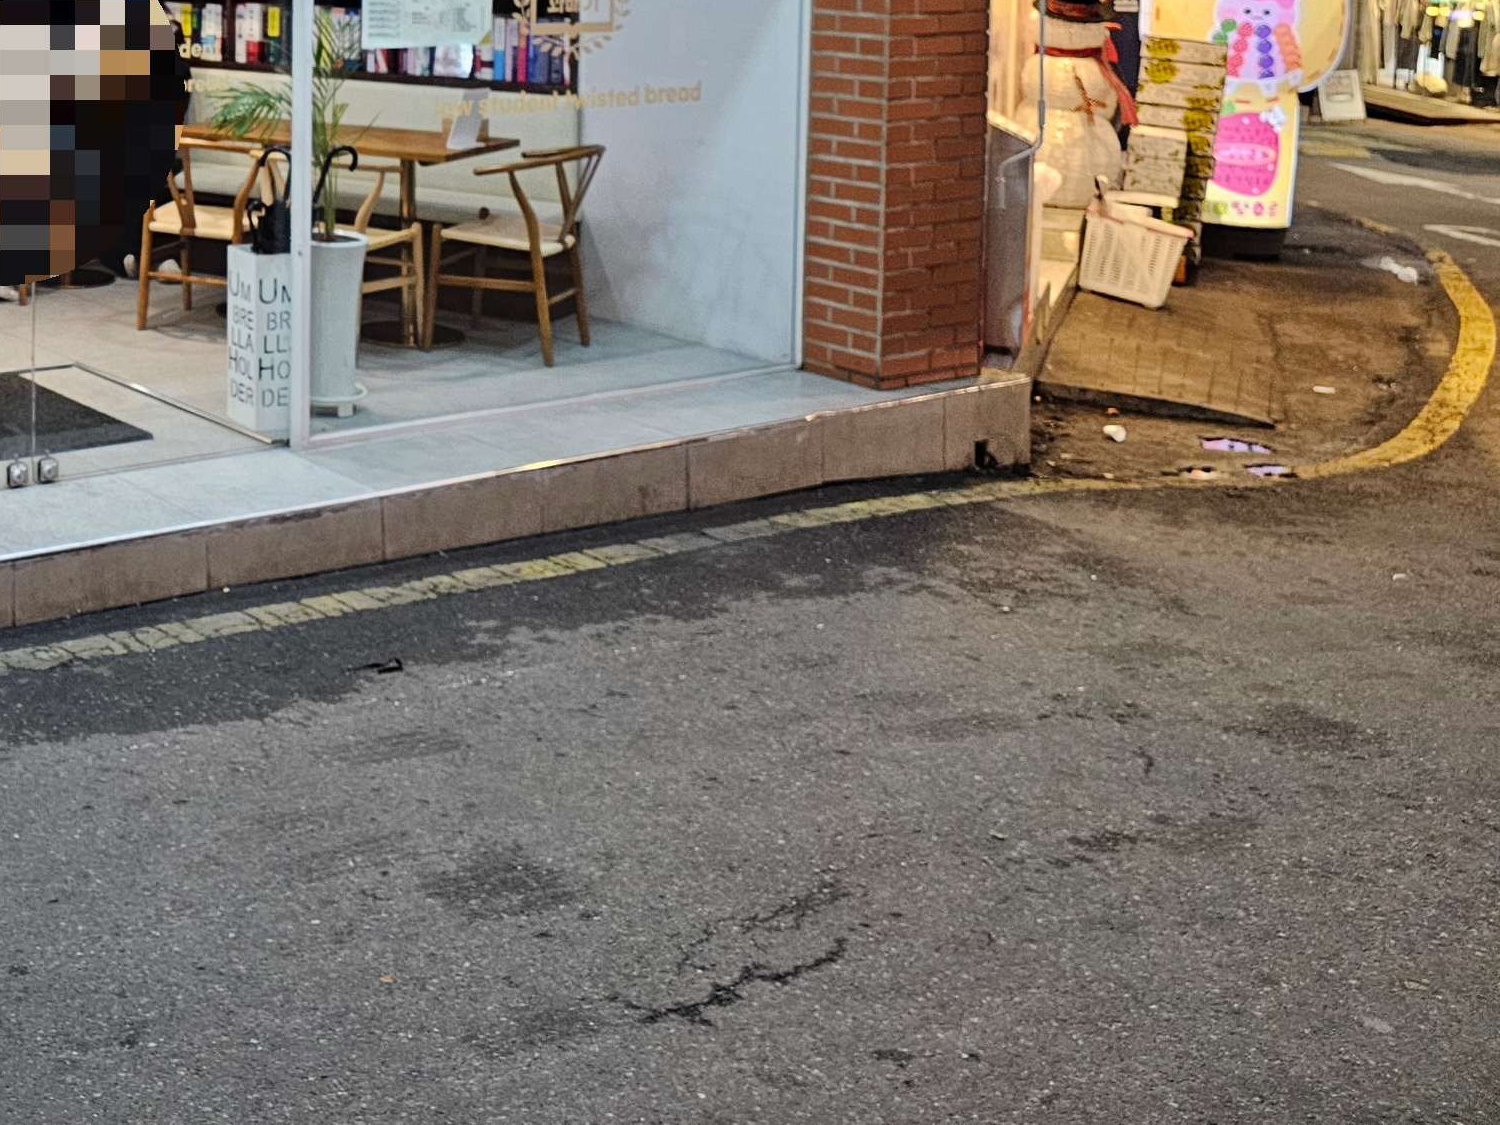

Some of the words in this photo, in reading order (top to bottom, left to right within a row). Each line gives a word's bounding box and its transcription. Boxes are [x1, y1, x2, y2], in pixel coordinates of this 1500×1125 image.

[478, 89, 559, 116] student
[564, 84, 640, 110] twisted
[643, 79, 702, 105] bread
